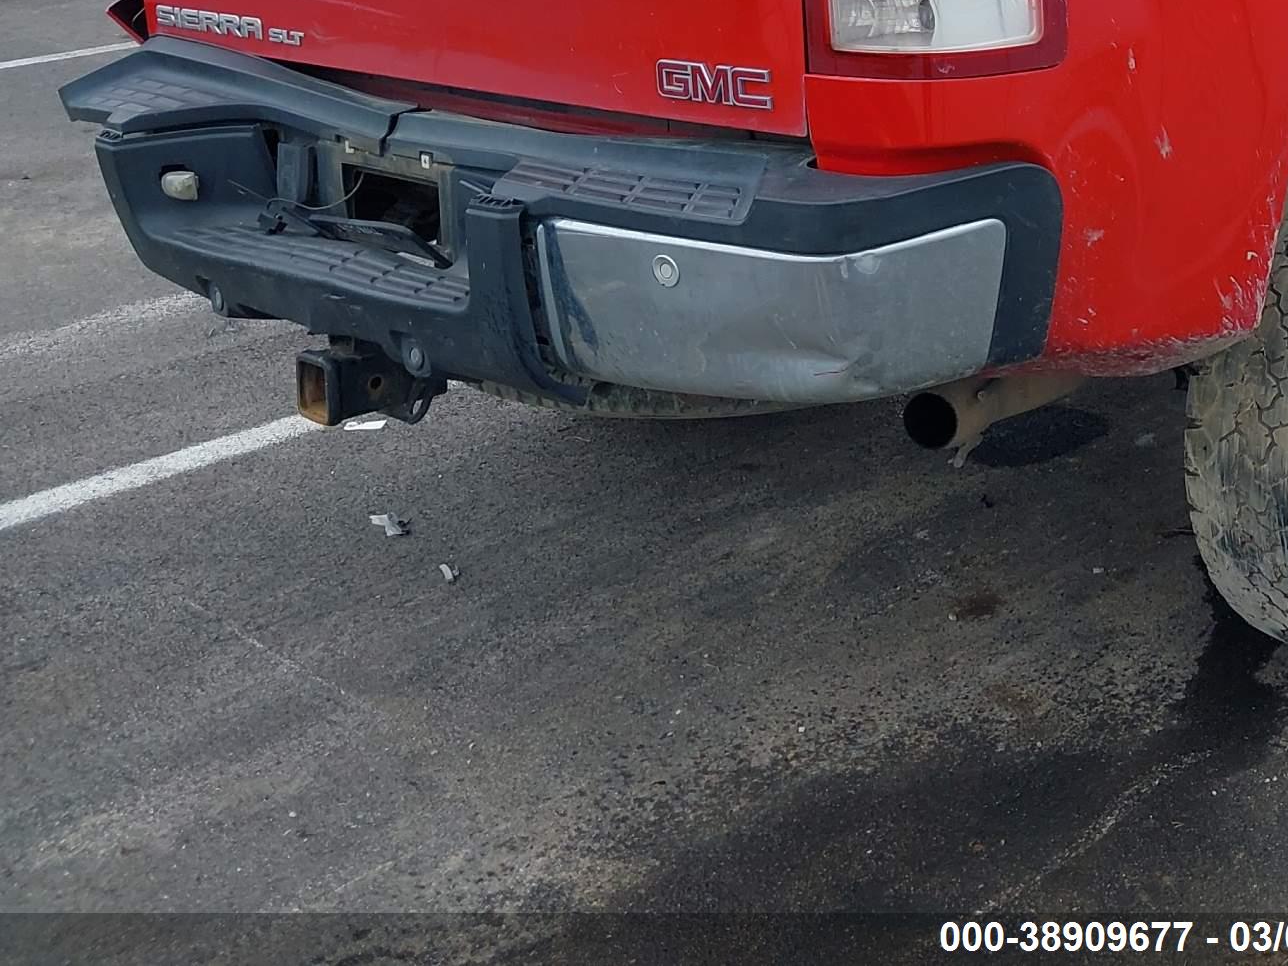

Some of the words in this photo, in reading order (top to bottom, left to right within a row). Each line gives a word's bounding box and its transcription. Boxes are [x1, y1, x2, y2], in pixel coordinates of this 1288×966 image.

[155, 4, 263, 41] SIERRA
[268, 27, 305, 46] SLT
[656, 59, 772, 110] GMC
